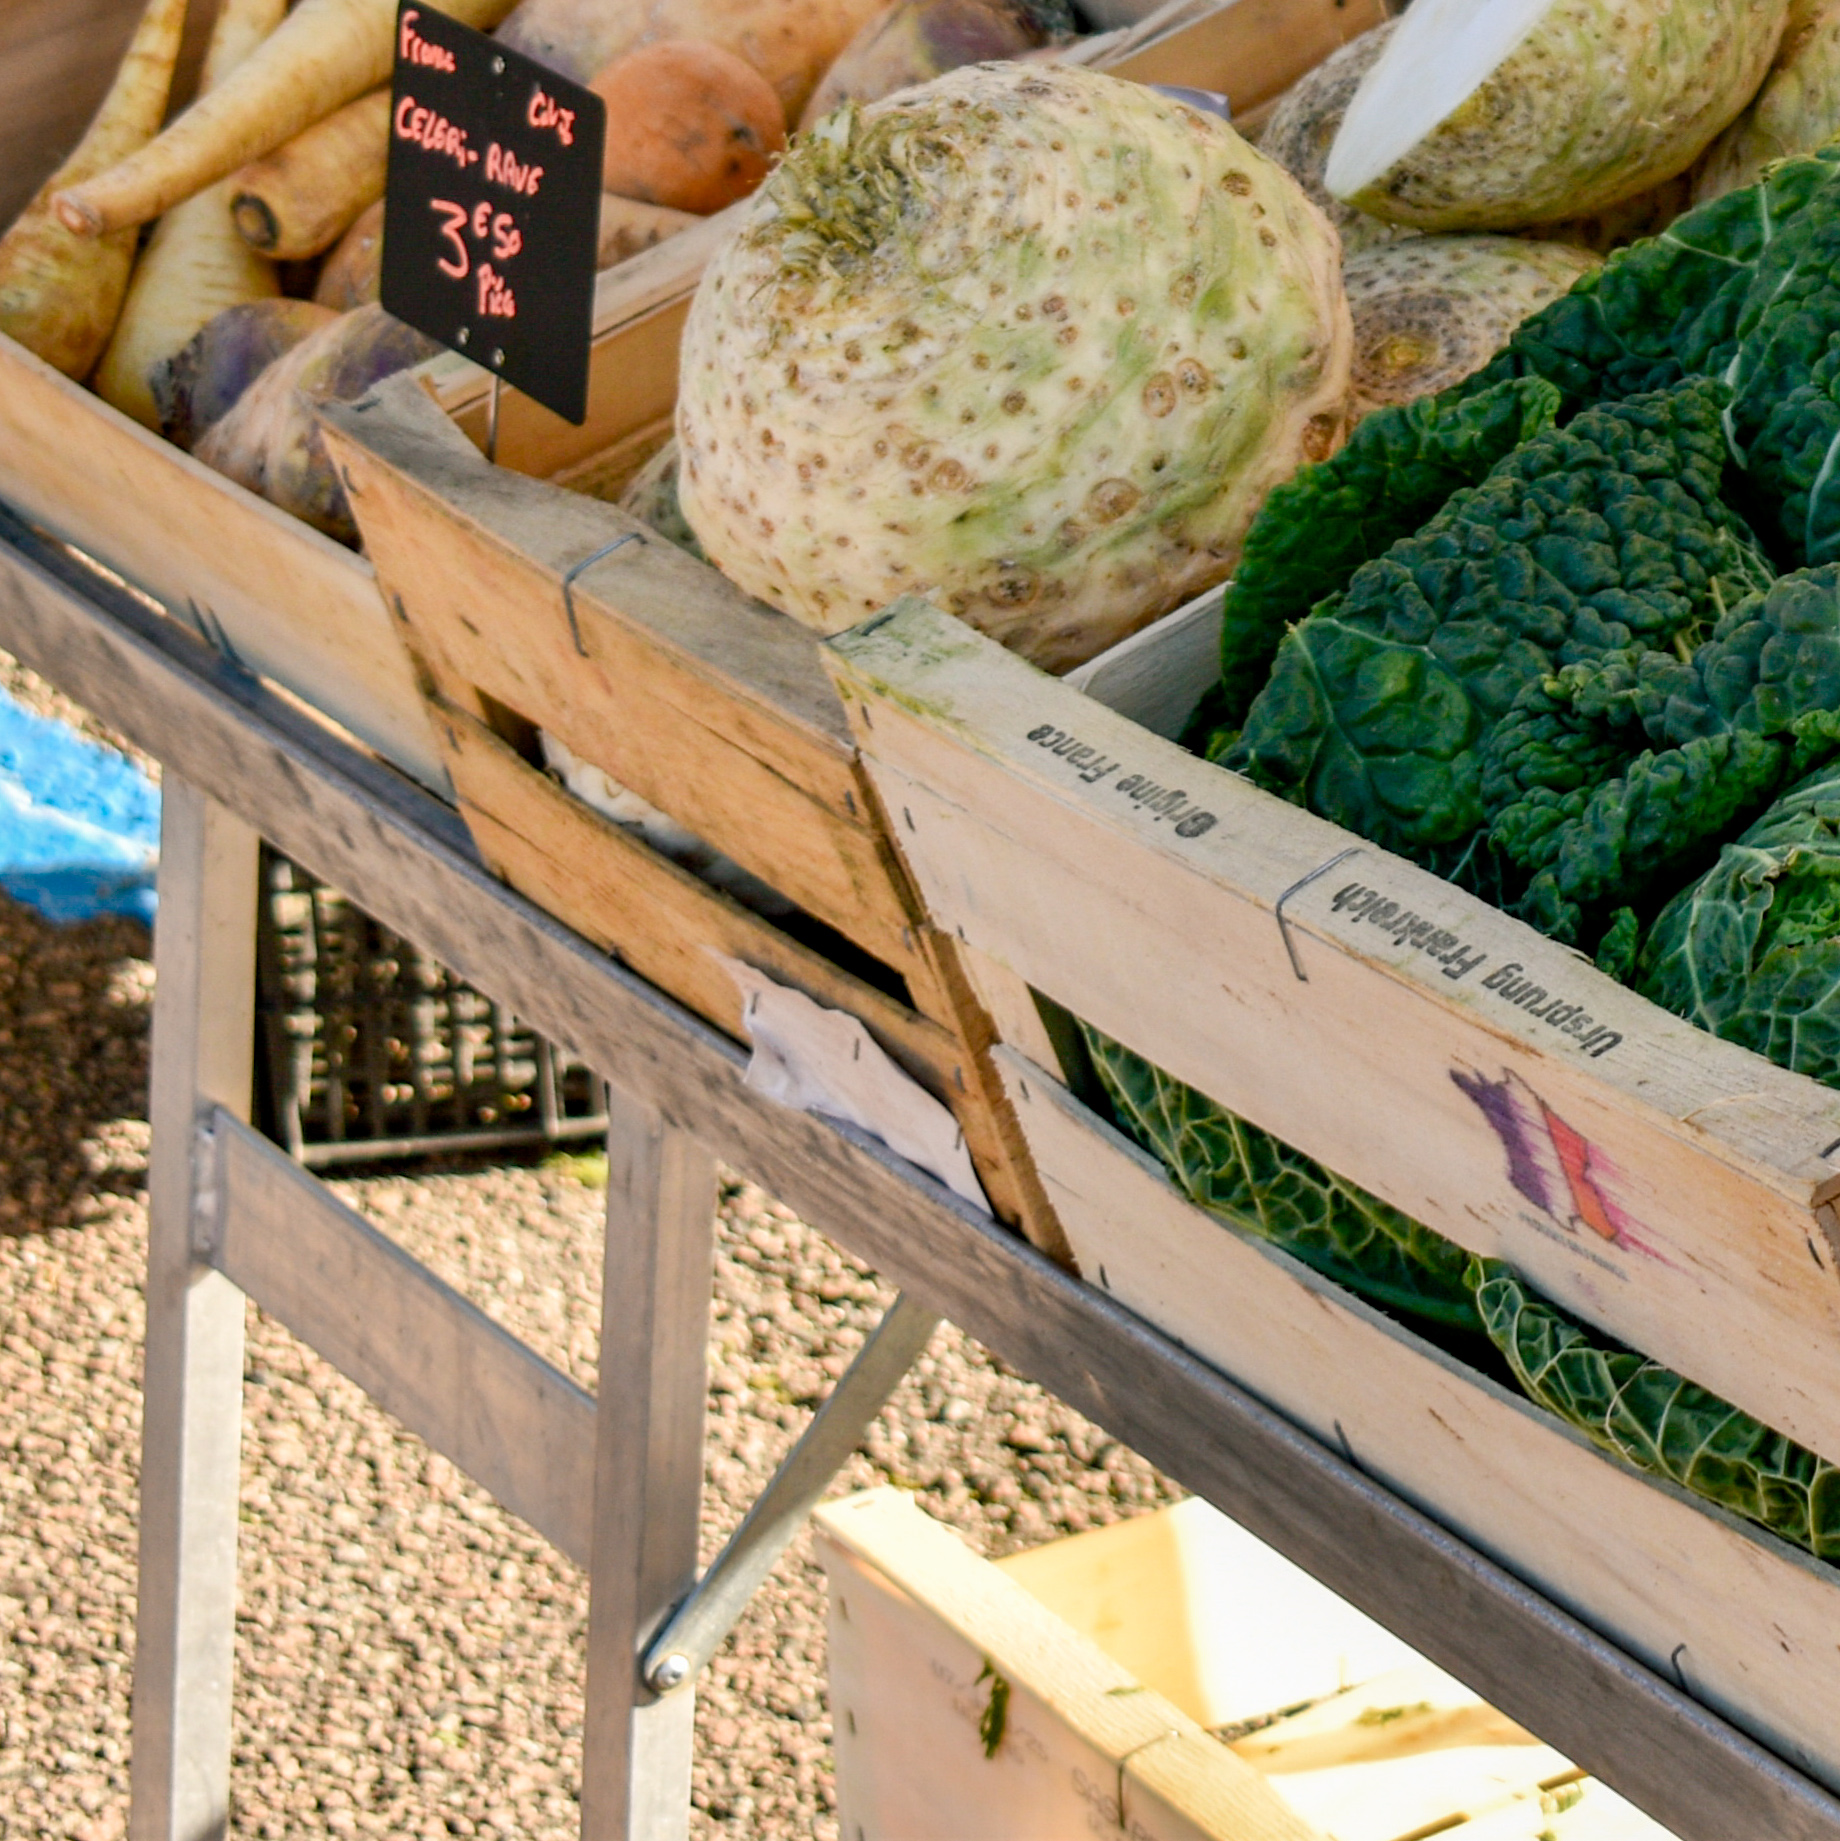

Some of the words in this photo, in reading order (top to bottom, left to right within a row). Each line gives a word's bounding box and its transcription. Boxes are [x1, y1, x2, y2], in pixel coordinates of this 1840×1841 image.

[1026, 722, 1108, 785] France
[1115, 774, 1219, 839] Origine
[1331, 881, 1487, 980] Frankreich
[1482, 964, 1624, 1058] Ursprung
